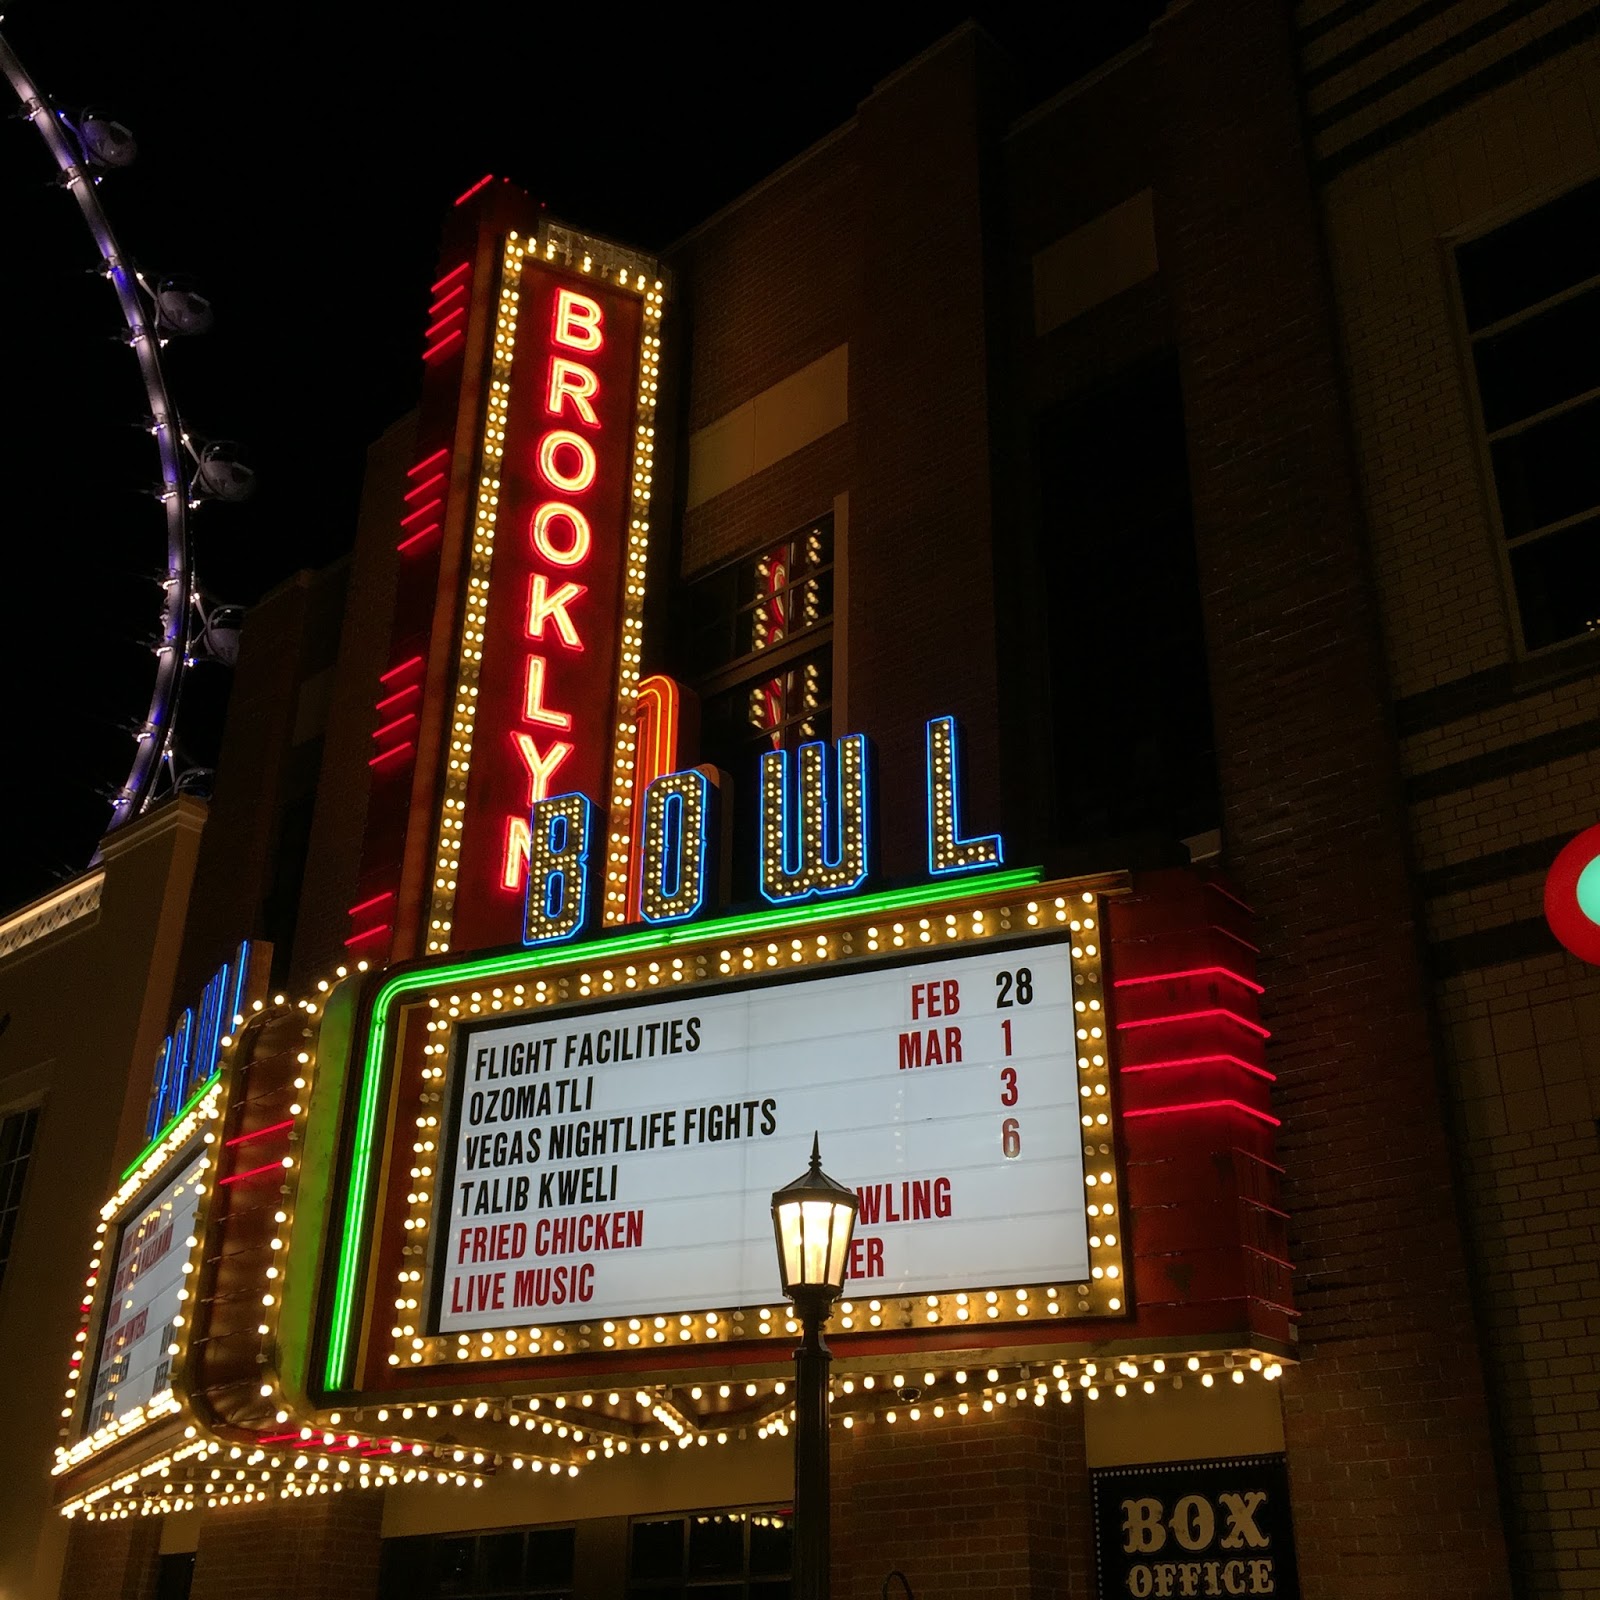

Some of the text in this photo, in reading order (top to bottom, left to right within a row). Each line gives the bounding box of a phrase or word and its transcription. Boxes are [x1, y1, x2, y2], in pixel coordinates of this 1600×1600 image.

[523, 715, 1005, 946] BOWL
[911, 967, 1034, 1021] FEB 28
[474, 1016, 701, 1082] FLIGHT FACILITIES
[898, 1019, 1012, 1070] MAR 1
[468, 1075, 594, 1126] OZOMATLI
[1000, 1067, 1019, 1107] 3
[466, 1098, 777, 1171] VEGAS NIGHTLIFE FIGHTS
[1002, 1118, 1021, 1159] 6
[459, 1164, 618, 1218] TALIB KWELI
[846, 1176, 952, 1225] WLING
[457, 1209, 644, 1265] FRIED CHICKEN
[844, 1237, 885, 1280] ER
[450, 1263, 595, 1314] LIVE MUSIC
[1121, 1491, 1270, 1554] BOX
[1126, 1558, 1274, 1598] OFFICE
